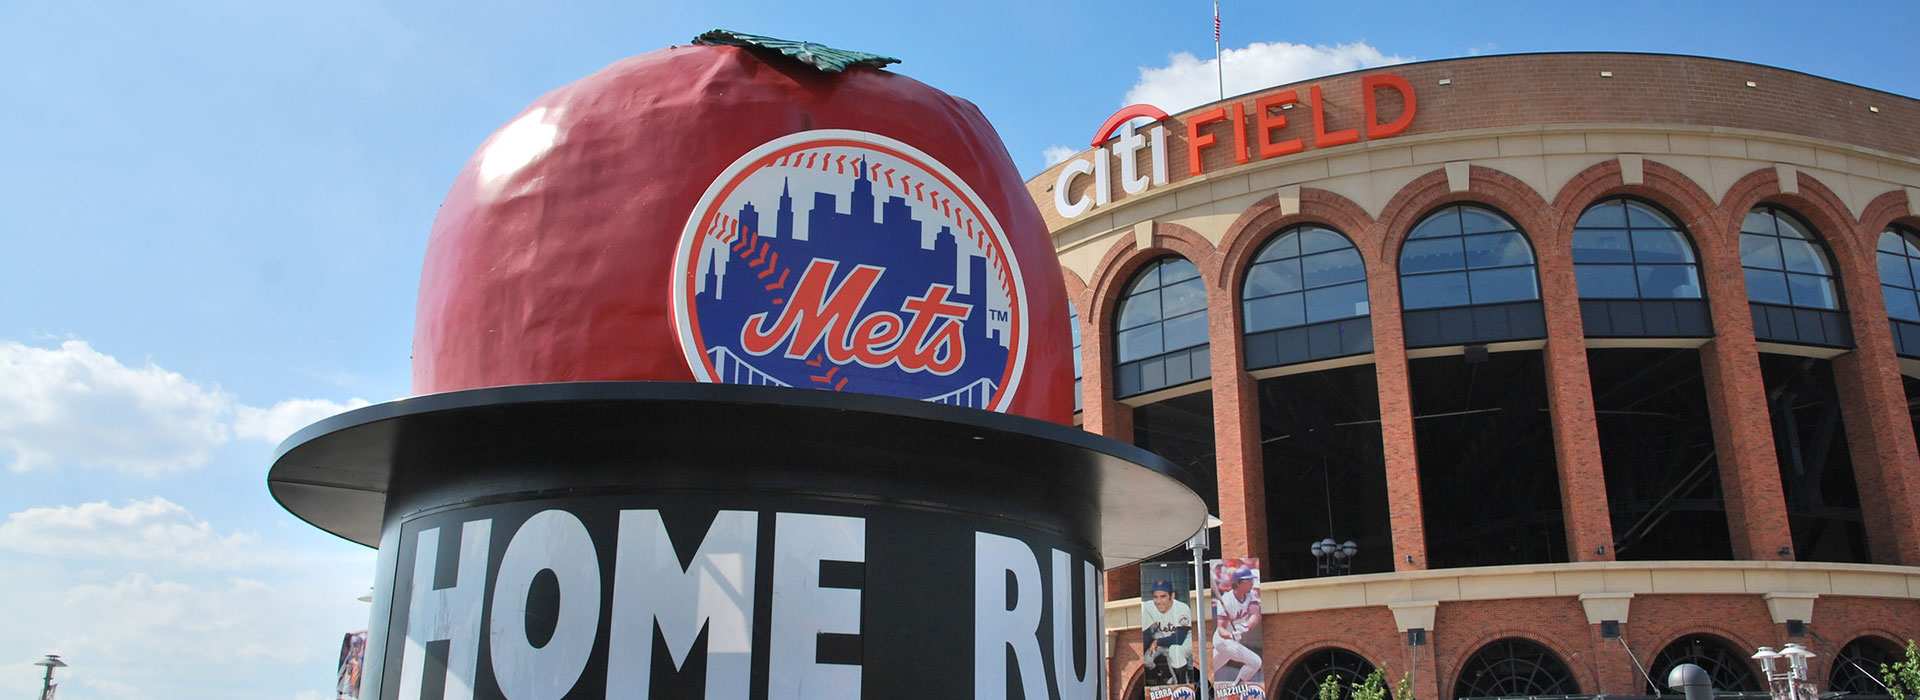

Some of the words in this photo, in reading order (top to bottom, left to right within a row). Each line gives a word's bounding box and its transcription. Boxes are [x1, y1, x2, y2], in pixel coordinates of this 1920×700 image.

[1054, 120, 1169, 219] citi
[1187, 73, 1416, 176] FIELD
[741, 257, 974, 377] Mets
[989, 308, 1009, 323] TM
[399, 508, 866, 700] HOME
[1150, 687, 1173, 700] BERRA
[1216, 684, 1249, 698] MAZZILLI
